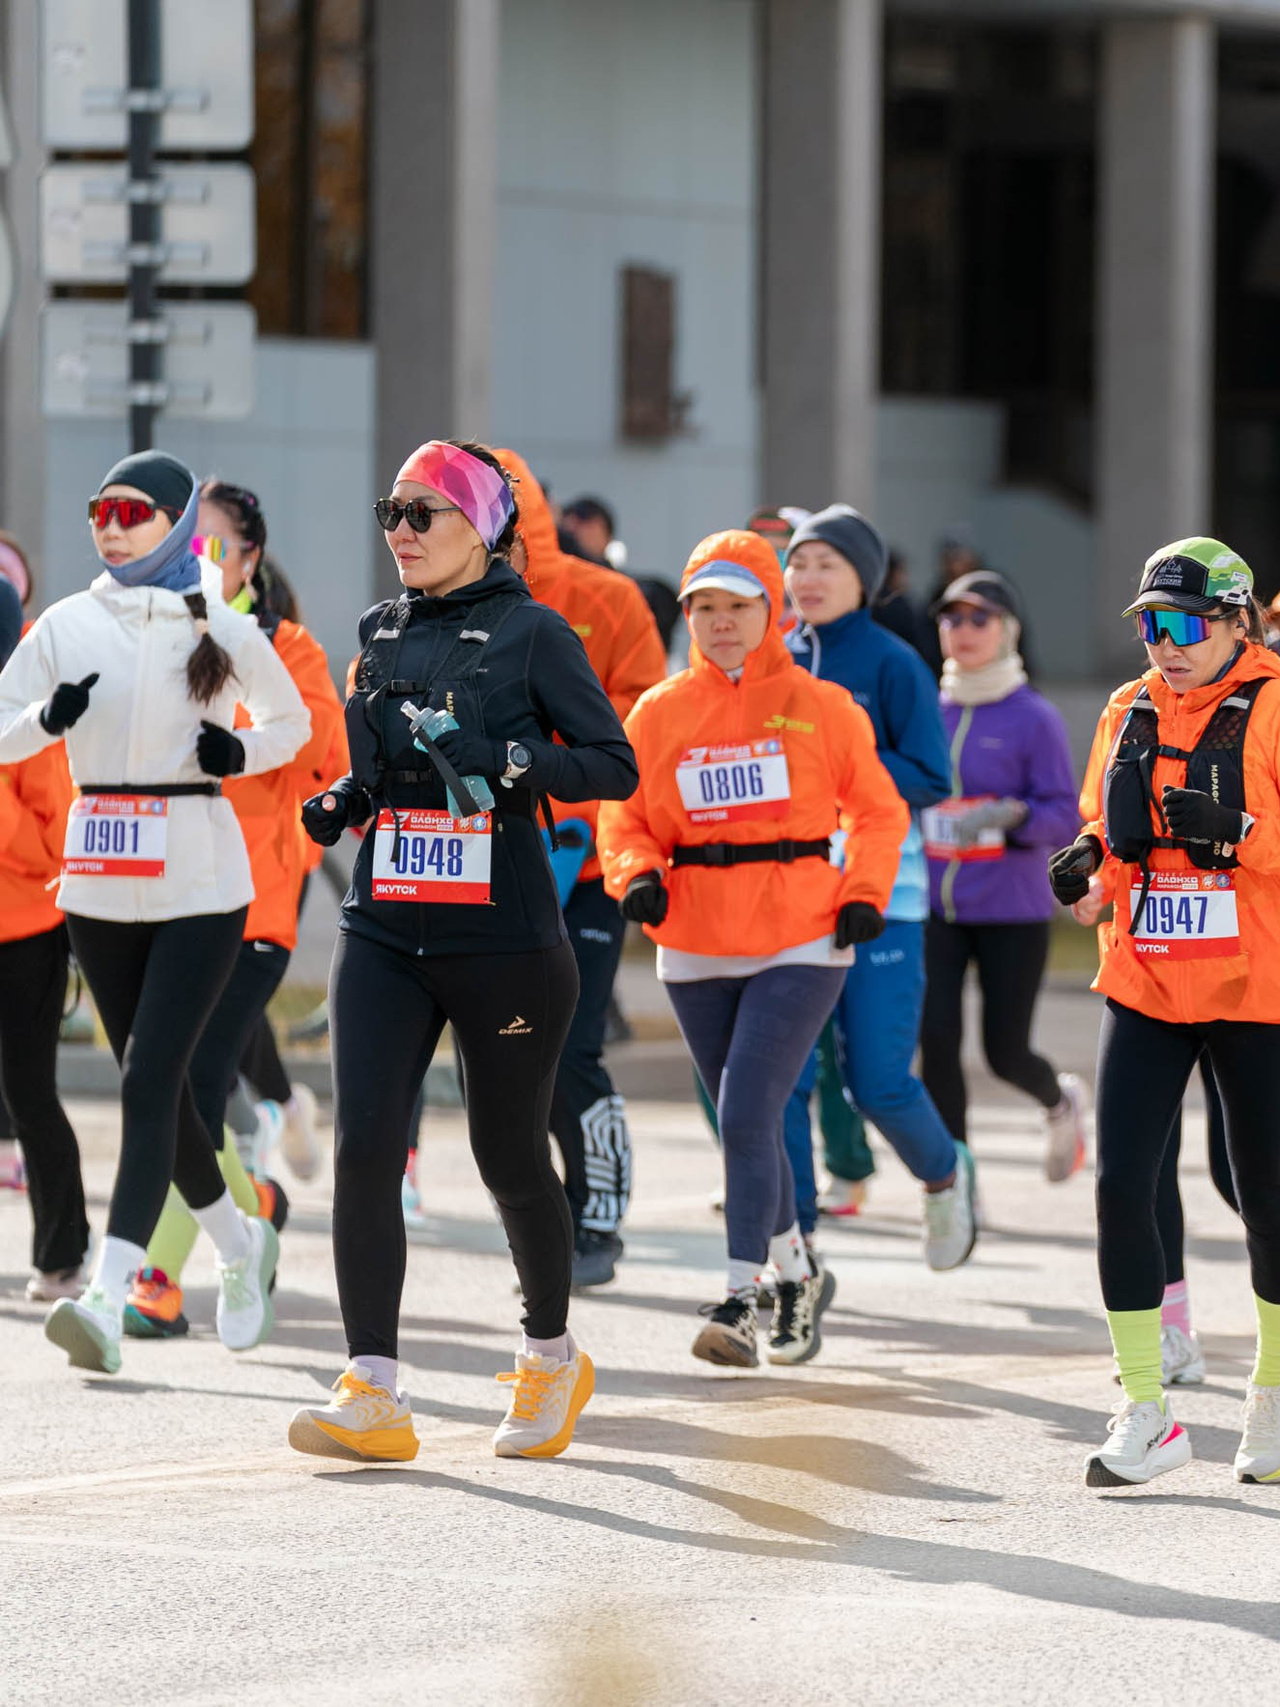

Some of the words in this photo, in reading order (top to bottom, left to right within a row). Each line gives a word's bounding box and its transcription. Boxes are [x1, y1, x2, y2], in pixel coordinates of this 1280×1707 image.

[699, 763, 764, 803] 0806
[84, 819, 139, 854] 0901
[395, 836, 464, 877] 0948
[376, 884, 418, 895] ЯКУТСК
[1145, 896, 1208, 934] 0947
